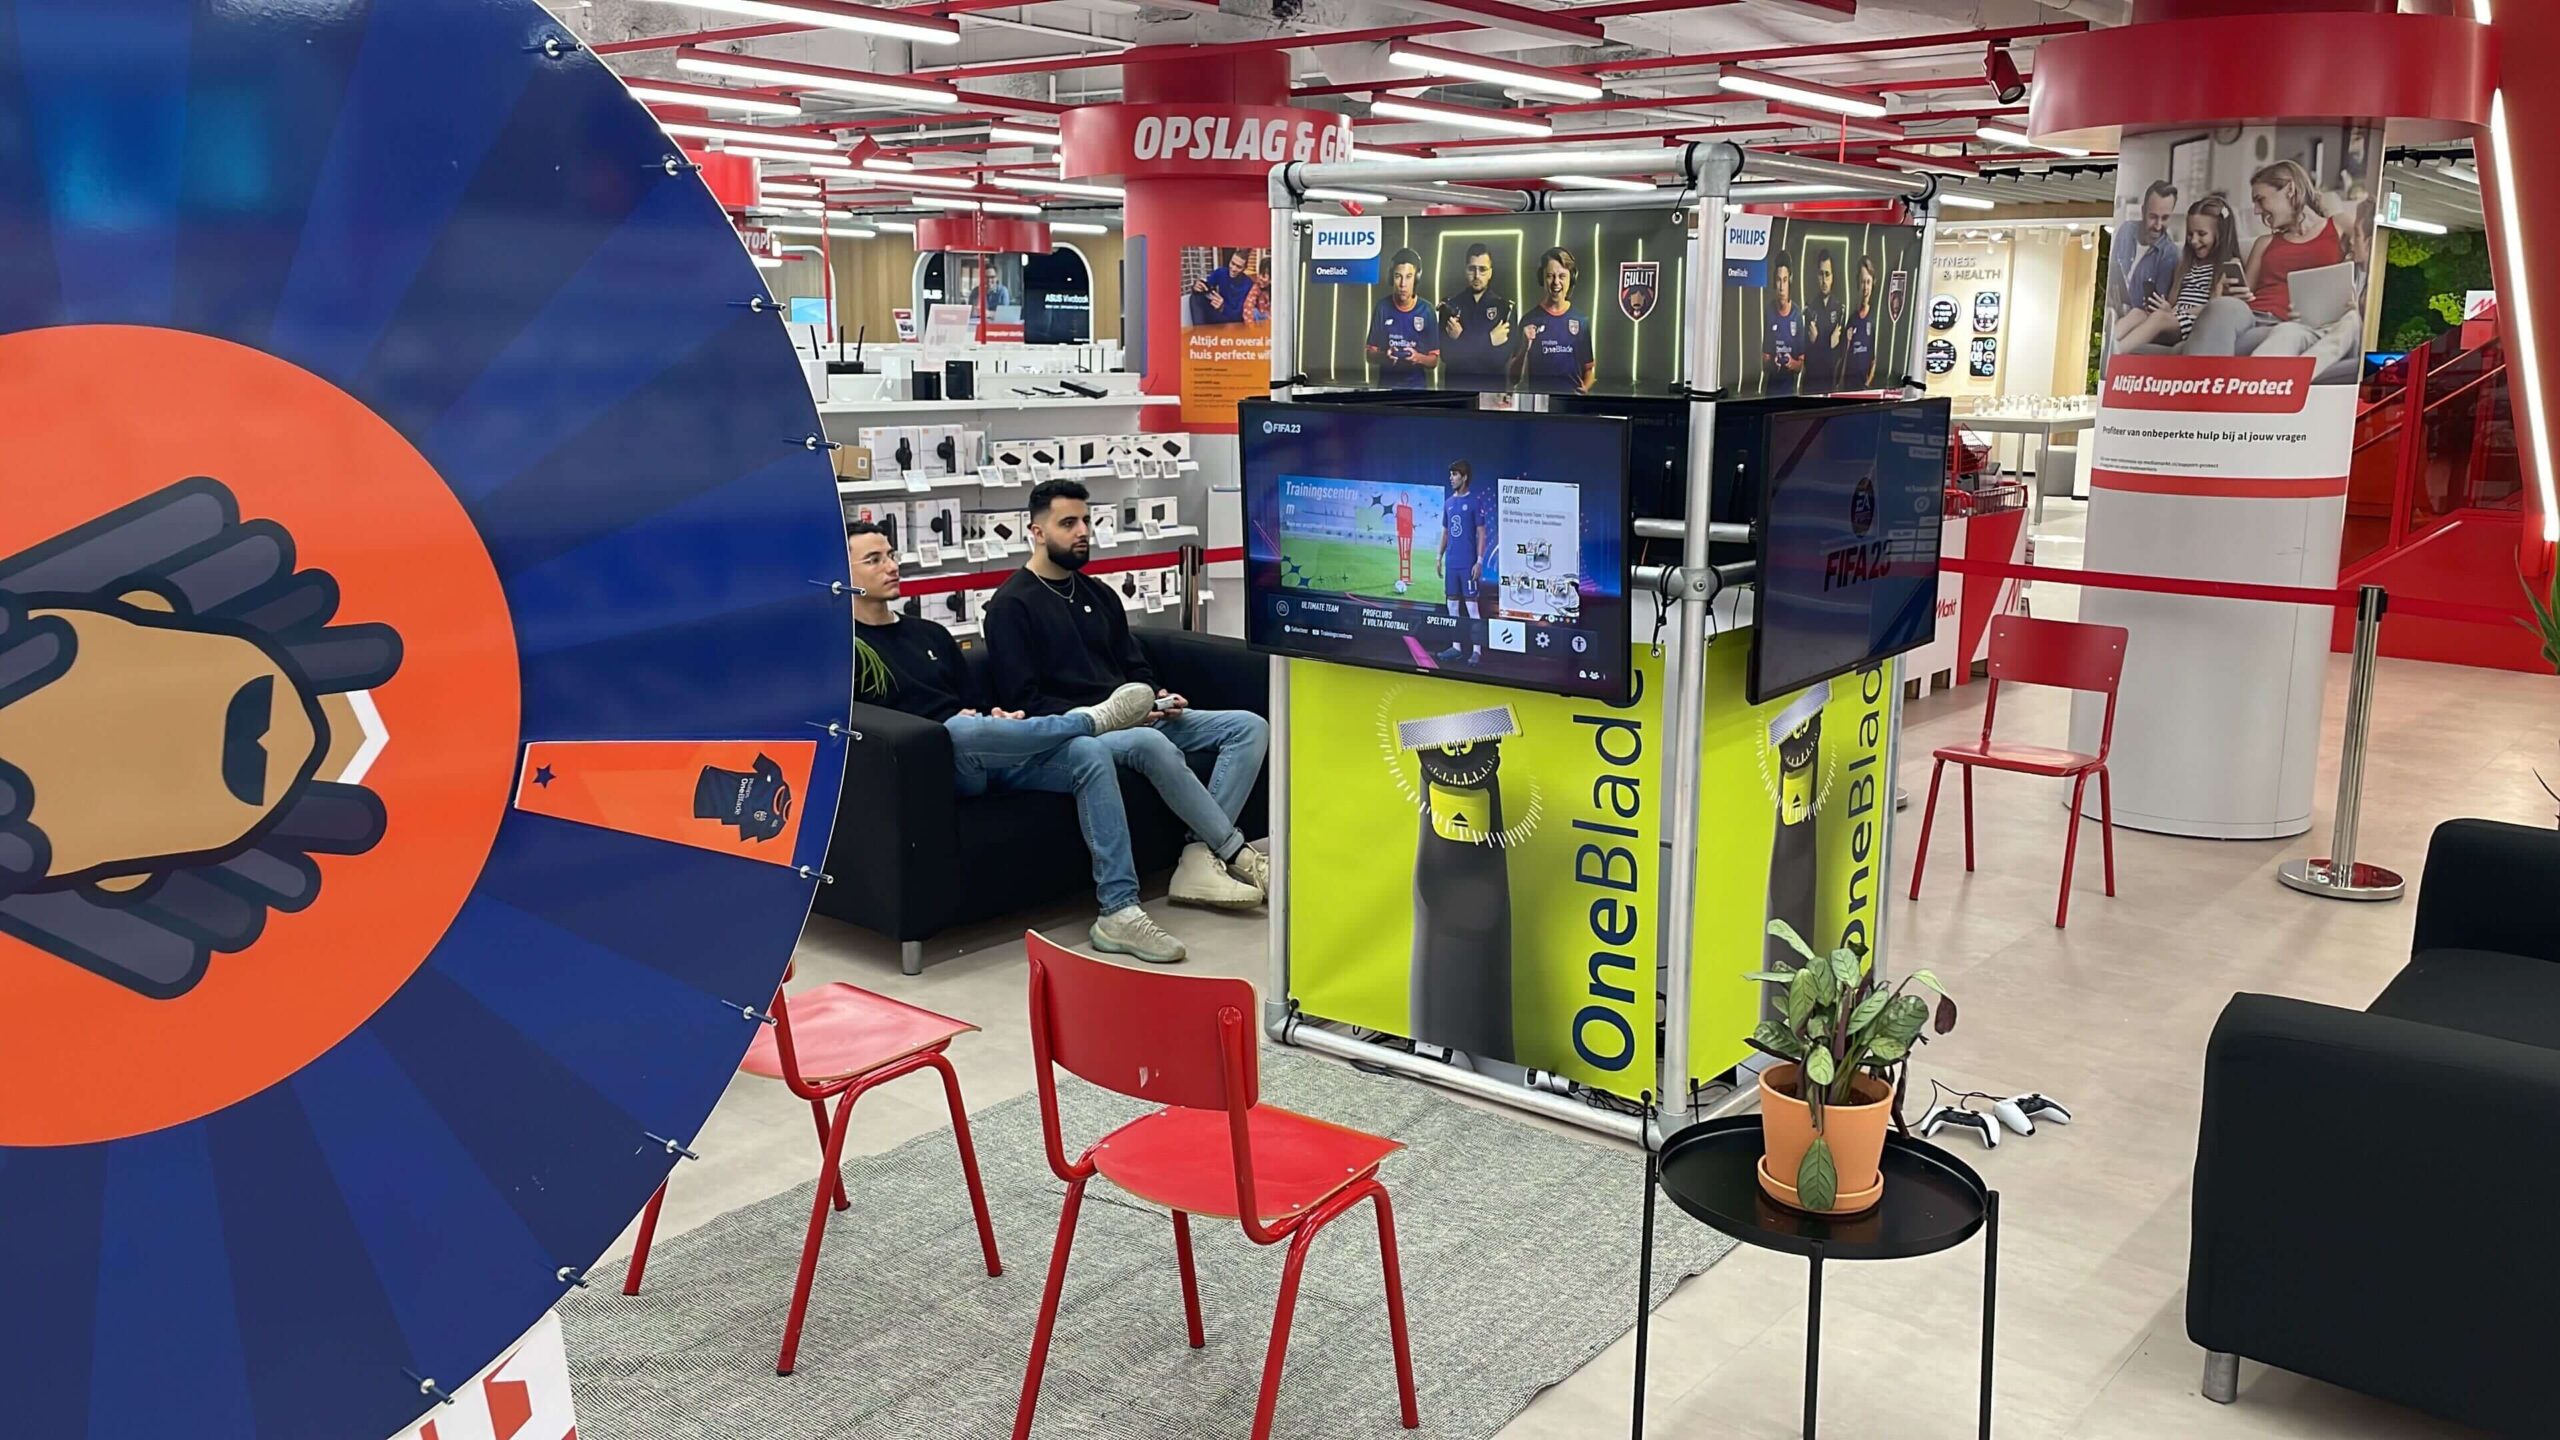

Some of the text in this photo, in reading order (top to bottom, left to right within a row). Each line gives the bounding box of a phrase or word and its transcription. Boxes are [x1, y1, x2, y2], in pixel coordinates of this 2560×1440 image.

[1134, 116, 1288, 162] OPSLAG
[1293, 121, 1316, 163] &
[1318, 231, 1375, 246] PHILIPS
[1729, 228, 1766, 246] PHILIPS
[1316, 267, 1348, 276] OneBlade
[1954, 269, 2002, 280] HEALTH
[1623, 271, 1655, 288] GULLIT
[1190, 336, 1218, 347] Altijd
[1235, 336, 1264, 346] overal
[1190, 349, 1212, 359] huis
[1214, 349, 1257, 361] perfecte
[2112, 375, 2294, 396] Altijd Support & Protect
[1273, 423, 1302, 434] FIFA 23
[2102, 425, 2308, 443] Profiteer van onbeperkte hulp bij al jouw vragen
[1286, 481, 1359, 500] Trainingscentru
[1502, 485, 1542, 496] FUT BIRTHDAY
[1502, 496, 1520, 505] ICONS
[1286, 503, 1295, 515] m
[1824, 539, 1892, 592] FIFA 23
[1301, 601, 1340, 613] ULTIMATE TEAM
[1362, 608, 1393, 619] PROFCLUBS
[1367, 618, 1383, 627] VOLTA
[1384, 620, 1409, 631] FOOTBALL
[1426, 616, 1457, 627] SPELTYPEN
[734, 778, 749, 815] OneBlade
[1839, 659, 1883, 960] OneBlad
